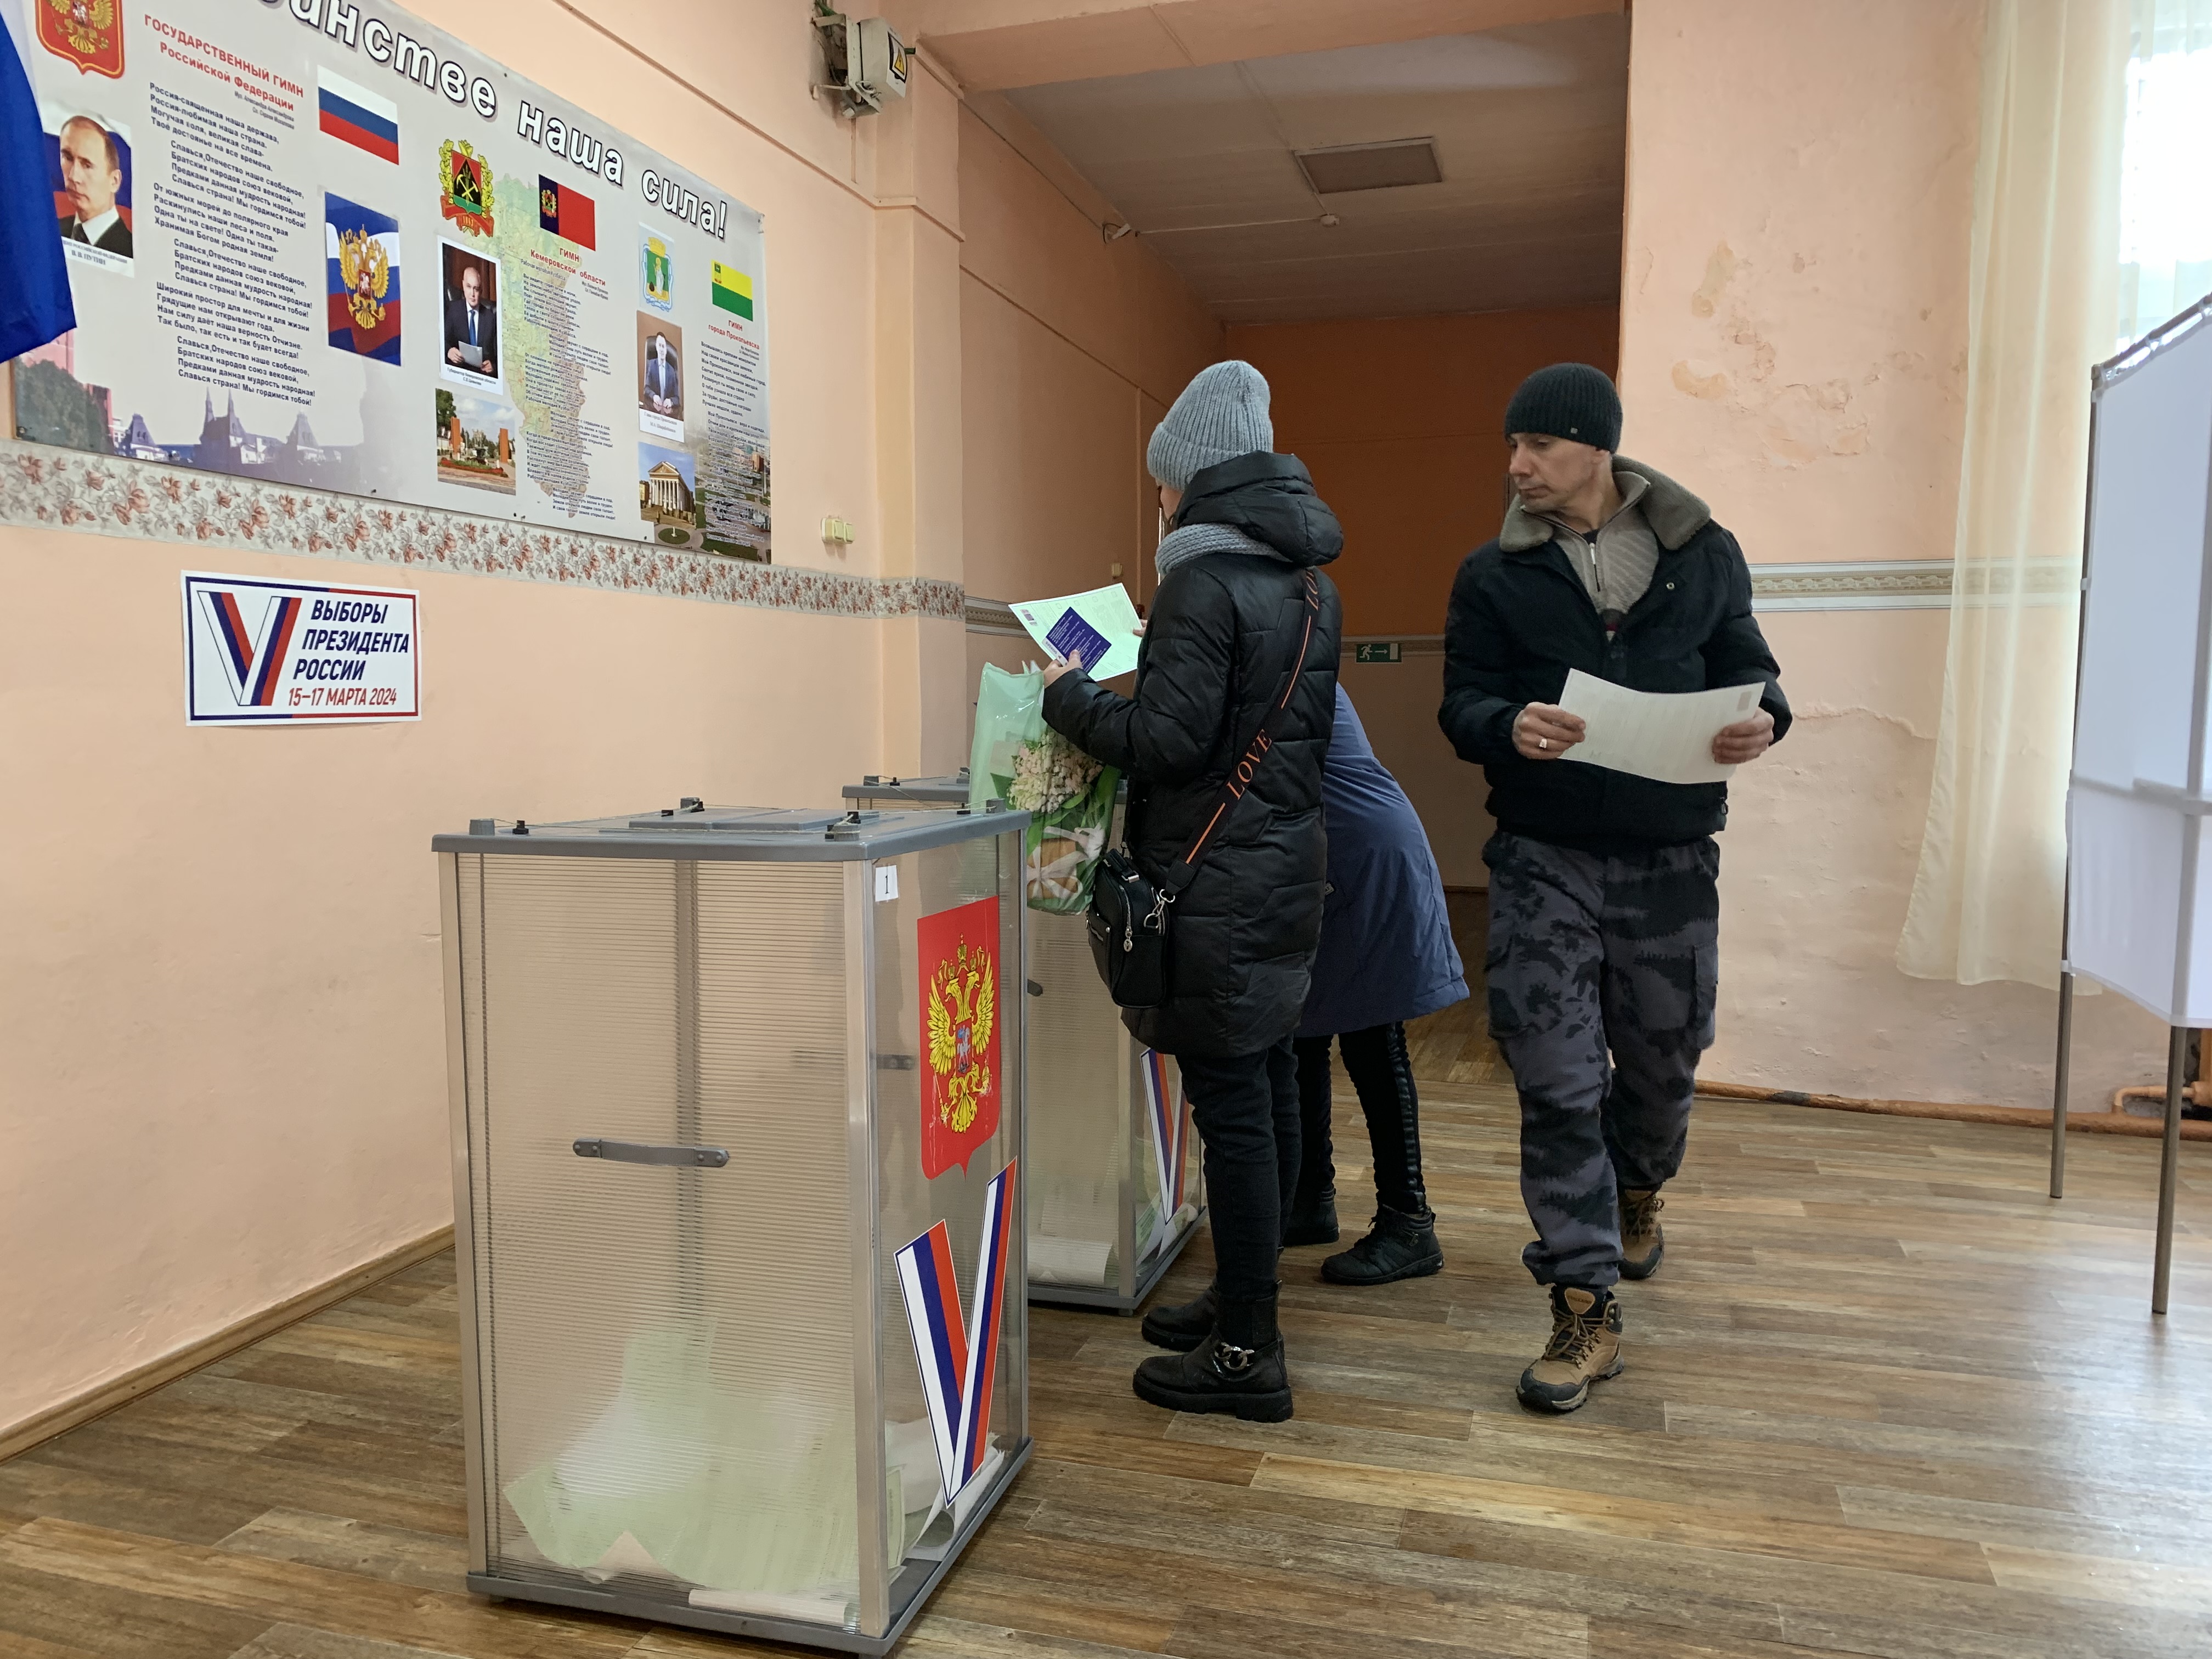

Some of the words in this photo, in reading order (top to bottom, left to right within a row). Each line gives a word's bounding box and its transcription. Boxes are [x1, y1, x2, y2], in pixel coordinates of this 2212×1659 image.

[145, 14, 269, 82] ГОСУДАРСТВЕННЫЙ
[273, 75, 303, 97] ГИМН
[160, 41, 230, 82] Российской
[234, 76, 293, 111] Федерации
[149, 82, 223, 120] Россия-священная
[225, 116, 245, 128] наша
[246, 125, 279, 144] держава,
[150, 93, 216, 127] Россия-любимая
[218, 123, 238, 137] наша
[240, 133, 267, 148] страна.
[150, 104, 184, 125] Могучая
[208, 130, 239, 147] великая
[259, 0, 496, 118] инстве
[517, 100, 623, 186] наша
[641, 168, 727, 239] сила!
[172, 127, 212, 147] достоянье
[214, 143, 223, 152] на
[225, 148, 238, 157] все
[240, 154, 273, 171] времена.
[171, 150, 207, 171] Братских
[210, 167, 240, 183] народов
[242, 180, 261, 191] союз
[263, 188, 292, 205] вековой,
[171, 162, 209, 182] Предками
[211, 179, 237, 193] данная
[239, 189, 270, 206] мудрость
[272, 201, 306, 218] народная!
[245, 170, 264, 182] наше
[266, 178, 304, 199] свободное,
[153, 182, 163, 192] От
[165, 188, 194, 204] южных
[196, 199, 220, 212] морей
[233, 212, 270, 230] полярного
[272, 227, 288, 236] края
[154, 193, 206, 218] Раскинулись
[207, 213, 228, 225] наши
[230, 222, 247, 232] леса
[256, 230, 274, 242] поля.
[172, 173, 204, 191] Славься
[206, 188, 234, 202] страна!
[236, 197, 248, 207] Мы
[250, 204, 283, 221] гордимся
[285, 216, 306, 229] тобой!
[154, 205, 174, 218] Одна
[176, 214, 187, 222] ты
[189, 218, 198, 227] на
[200, 222, 223, 235] свете!
[225, 229, 244, 242] Одна
[246, 238, 255, 246] ты
[154, 216, 194, 236] Хранимая
[196, 230, 219, 244] Богом
[222, 240, 247, 253] родная
[250, 250, 273, 262] земля!
[174, 249, 210, 267] Братских
[212, 263, 243, 277] народов
[245, 273, 264, 284] союз
[266, 279, 295, 295] вековой,
[248, 263, 267, 274] наше
[268, 270, 306, 288] свободное,
[531, 249, 575, 274] Кемеровской
[579, 272, 606, 286] области
[560, 248, 579, 262] ГИМН
[156, 281, 193, 298] Широкий
[195, 294, 225, 309] простор
[227, 303, 240, 312] для
[242, 308, 265, 319] мечты
[273, 317, 285, 325] для
[287, 320, 309, 331] жизни
[174, 260, 213, 278] Предками
[215, 274, 242, 287] данная
[244, 283, 276, 298] мудрость
[278, 294, 312, 309] народная!
[174, 272, 207, 287] Славься
[209, 283, 237, 296] страна!
[239, 290, 251, 301] Мы
[252, 296, 286, 311] гордимся
[287, 307, 308, 318] тобой!
[156, 292, 196, 310] Грядущие
[198, 306, 213, 315] нам
[215, 311, 255, 326] открывают
[257, 322, 274, 332] года.
[157, 303, 174, 315] Нам
[176, 311, 195, 323] силу
[196, 317, 214, 325] даёт
[216, 321, 236, 332] наша
[238, 327, 270, 341] верность
[272, 335, 302, 349] Отчизне.
[728, 320, 743, 331] ГИМН
[157, 315, 172, 326] Так
[174, 319, 197, 334] было,
[199, 328, 211, 336] так
[213, 331, 230, 341] есть
[239, 338, 250, 346] так
[252, 340, 272, 352] будет
[274, 347, 298, 359] всегда!
[708, 325, 725, 336] города
[726, 331, 759, 349] Прокопьевска
[177, 346, 213, 362] Братских
[216, 357, 246, 370] народов
[248, 365, 267, 375] союз
[268, 370, 298, 384] вековой,
[178, 357, 217, 374] Предками
[218, 369, 245, 380] данная
[247, 376, 280, 388] мудрость
[281, 384, 315, 397] народная!
[251, 356, 270, 365] наше
[272, 361, 309, 377] свободное,
[178, 369, 210, 382] Славься
[212, 378, 240, 390] страна!
[242, 383, 254, 392] Мы
[256, 388, 289, 400] гордимся
[290, 396, 311, 406] тобой!
[311, 599, 388, 624] ВЫБОРЫ
[302, 629, 409, 655] ПРЕЗИДЕНТА
[292, 658, 366, 680] РОССИИ
[325, 687, 367, 706] МАРТА
[369, 687, 397, 706] 2024
[1226, 729, 1272, 800] LOVE
[885, 874, 890, 894] 1
